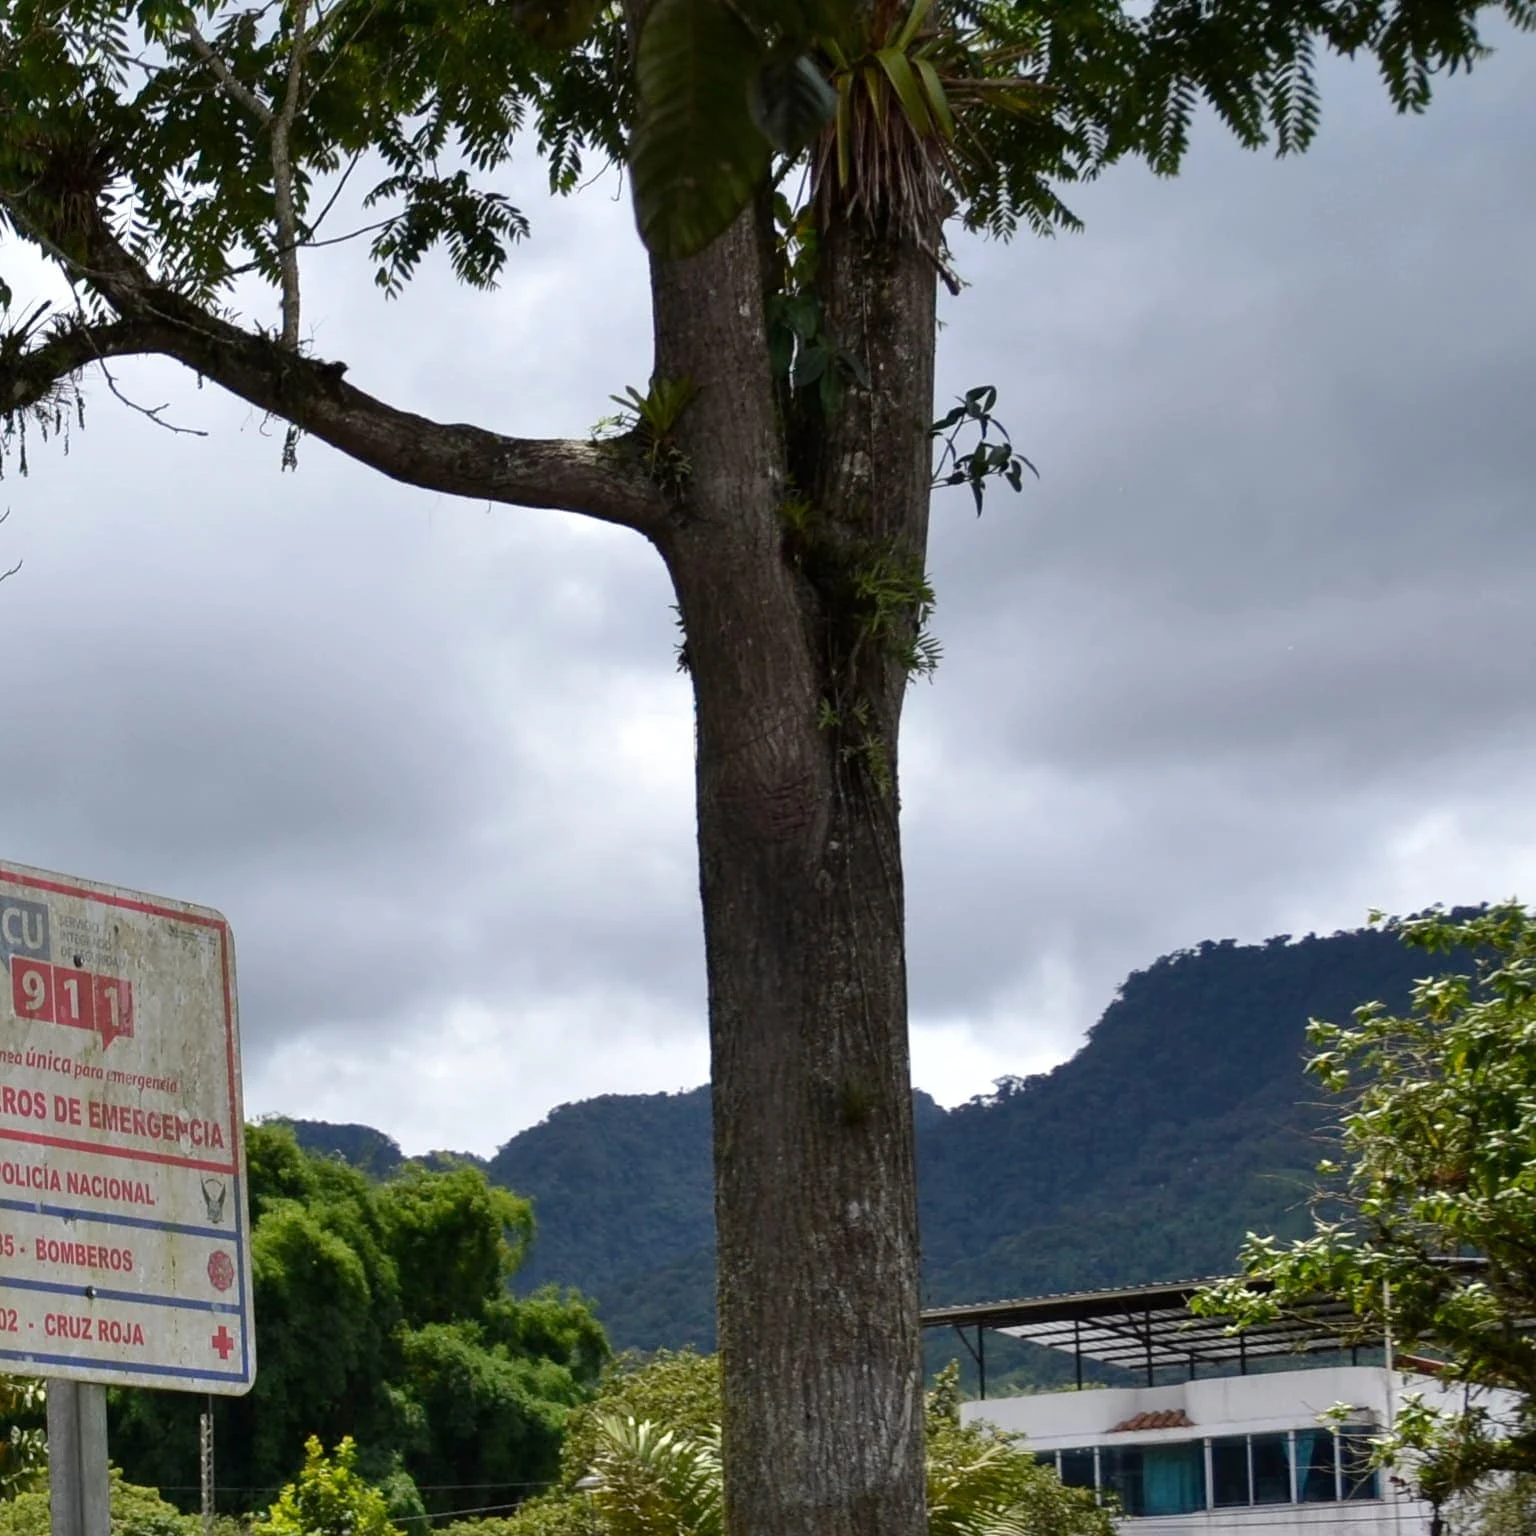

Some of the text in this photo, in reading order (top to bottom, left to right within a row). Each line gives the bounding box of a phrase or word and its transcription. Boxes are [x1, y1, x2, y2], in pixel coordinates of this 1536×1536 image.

[23, 970, 119, 1027] 911
[26, 1047, 71, 1073] única
[74, 1063, 104, 1079] para
[54, 1095, 82, 1125] DE
[89, 1103, 224, 1149] EMERGENCIA
[67, 1172, 155, 1205] NACIONAL
[35, 1238, 133, 1272] BOMBEROS
[45, 1313, 93, 1340] CRUZ
[98, 1319, 144, 1345] ROJA
